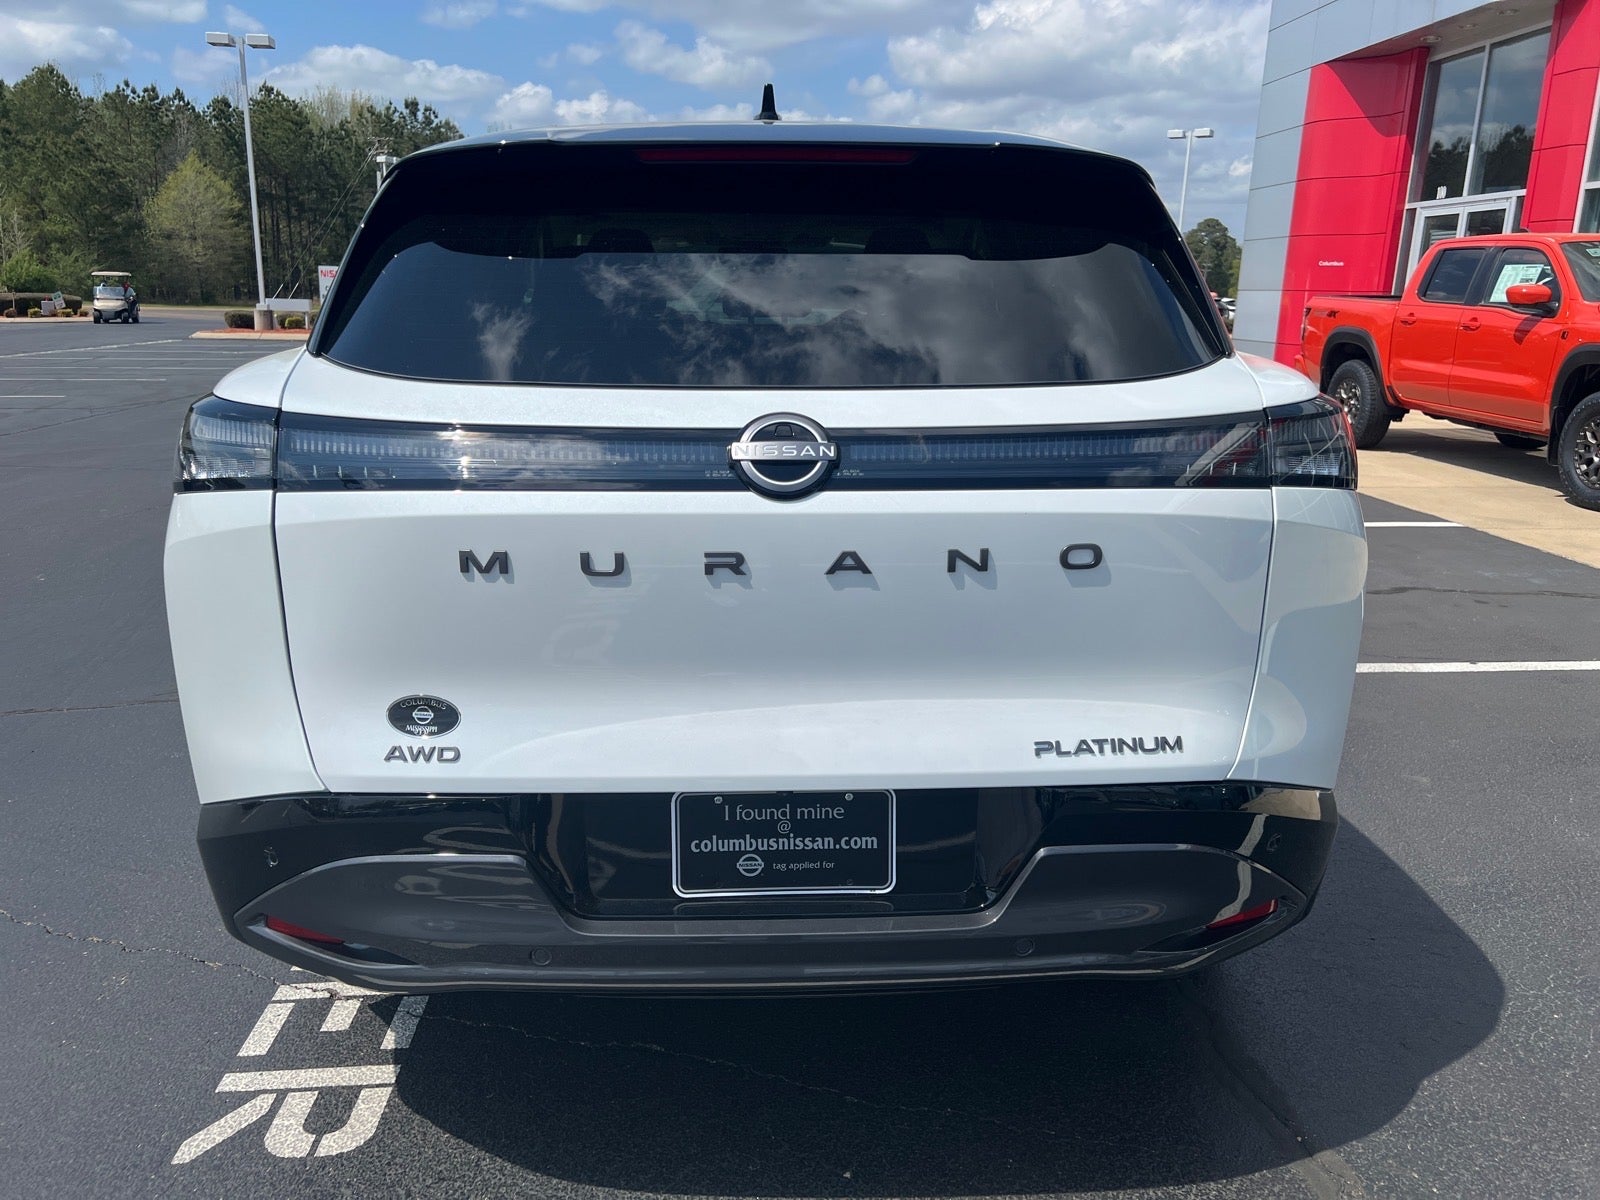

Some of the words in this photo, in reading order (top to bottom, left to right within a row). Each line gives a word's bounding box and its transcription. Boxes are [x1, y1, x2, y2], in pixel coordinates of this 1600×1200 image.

[733, 444, 835, 457] NISSAN
[458, 542, 1103, 577] MURANO
[400, 698, 447, 710] COLUMBUS
[383, 745, 461, 763] AWD
[1033, 735, 1183, 757] PLATINUM
[724, 804, 730, 821] I
[736, 803, 790, 821] found
[796, 803, 845, 820] mine
[690, 833, 878, 853] columbusnissan.com
[772, 862, 787, 871] tag
[788, 861, 820, 870] applied
[822, 860, 835, 869] for
